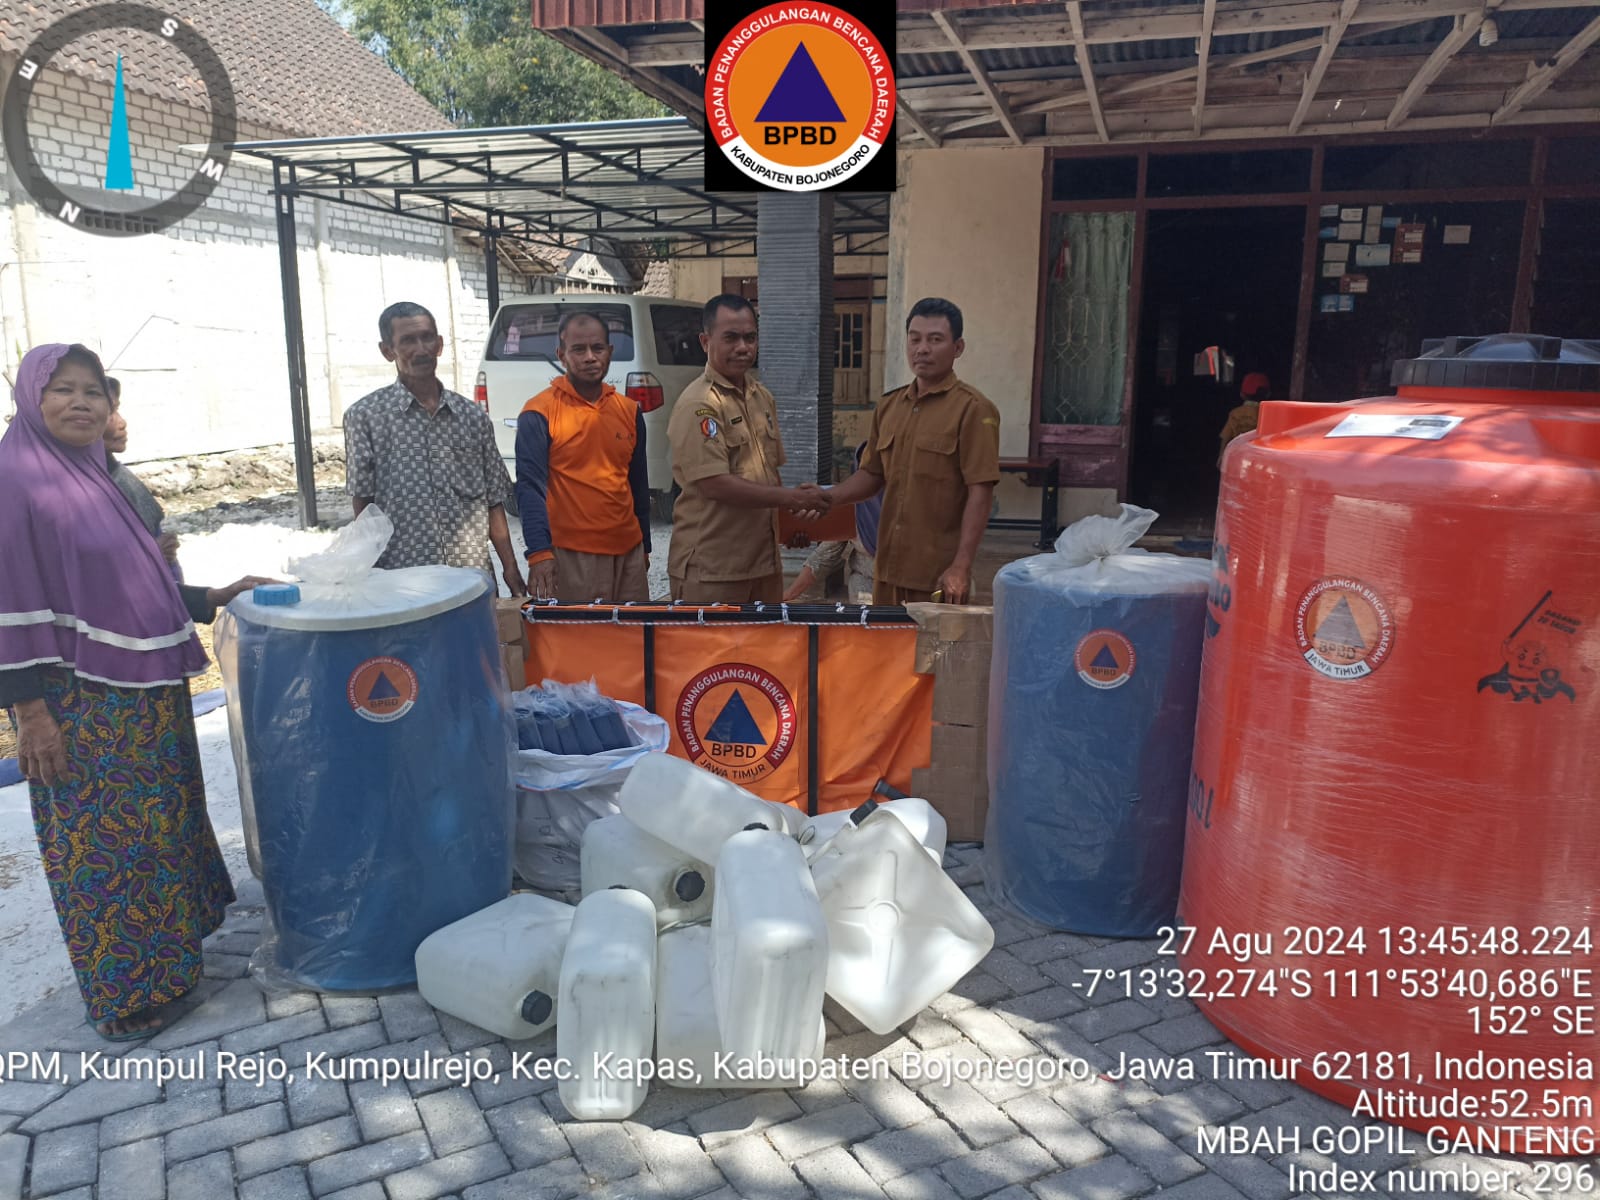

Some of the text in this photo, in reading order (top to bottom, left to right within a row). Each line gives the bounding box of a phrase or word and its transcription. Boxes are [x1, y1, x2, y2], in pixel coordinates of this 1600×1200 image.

[1297, 579, 1391, 663] BADAN PENANGGULANGAN BENCANA DAERAH
[1318, 640, 1356, 659] BPBD
[1308, 653, 1332, 673] JAWA
[681, 669, 792, 760] BADAN PENANGGULANGAN BENCANA DAERAH
[711, 743, 757, 759] BPBD
[700, 759, 767, 779] JAWA TIMUR
